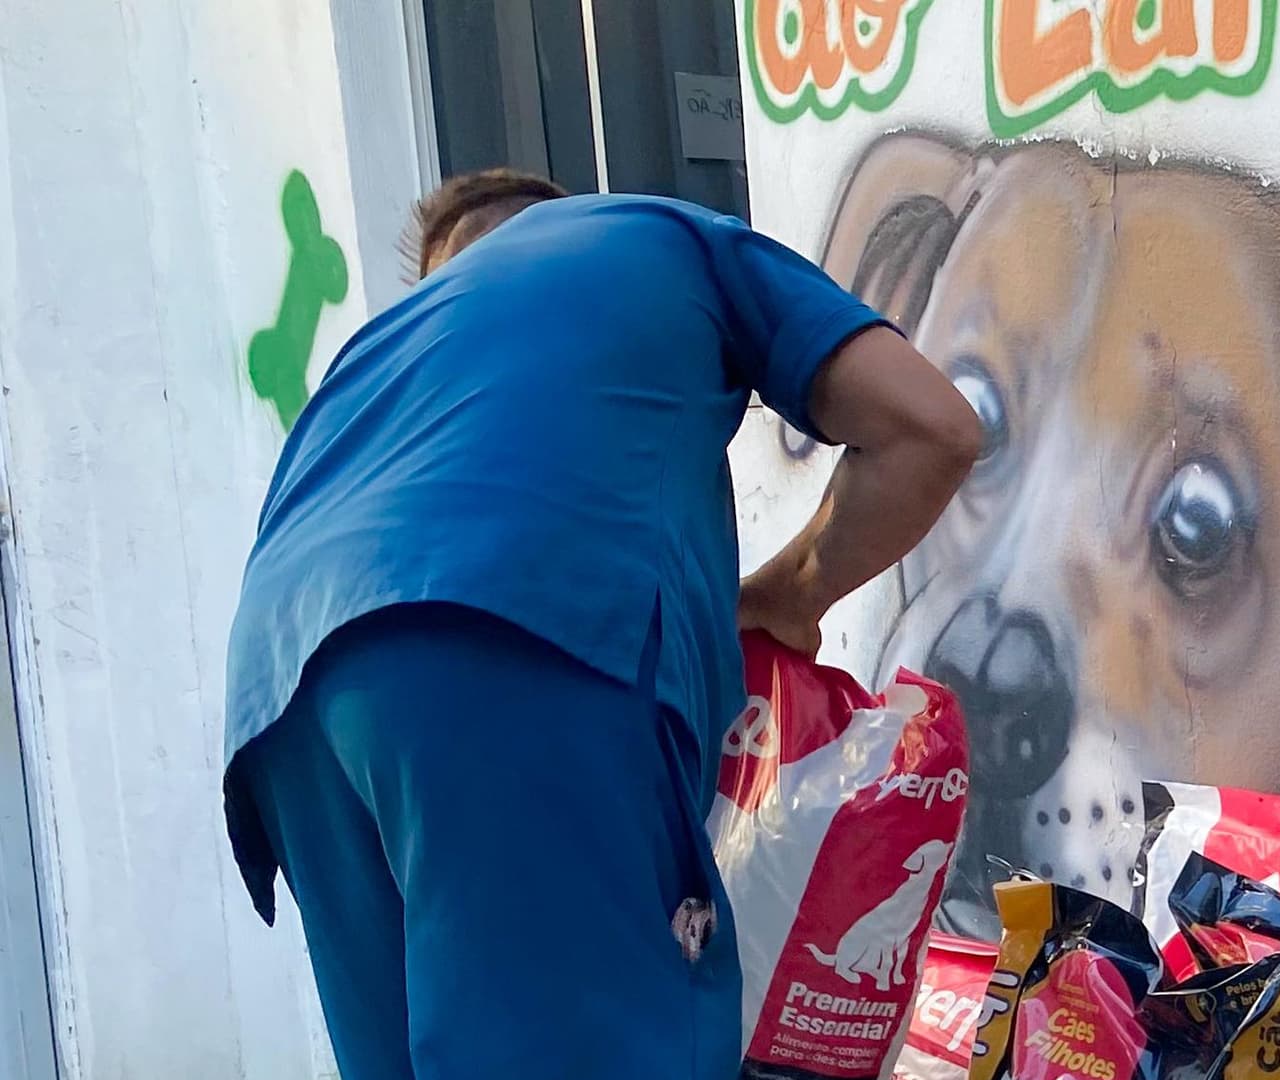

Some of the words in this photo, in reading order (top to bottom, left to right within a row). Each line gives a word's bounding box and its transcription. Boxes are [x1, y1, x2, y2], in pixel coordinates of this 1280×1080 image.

[786, 982, 897, 1017] Premium
[1226, 980, 1257, 997] Pelos
[780, 1005, 892, 1040] Essencial
[1047, 1008, 1096, 1043] Cães
[1024, 1029, 1116, 1080] Filhotes
